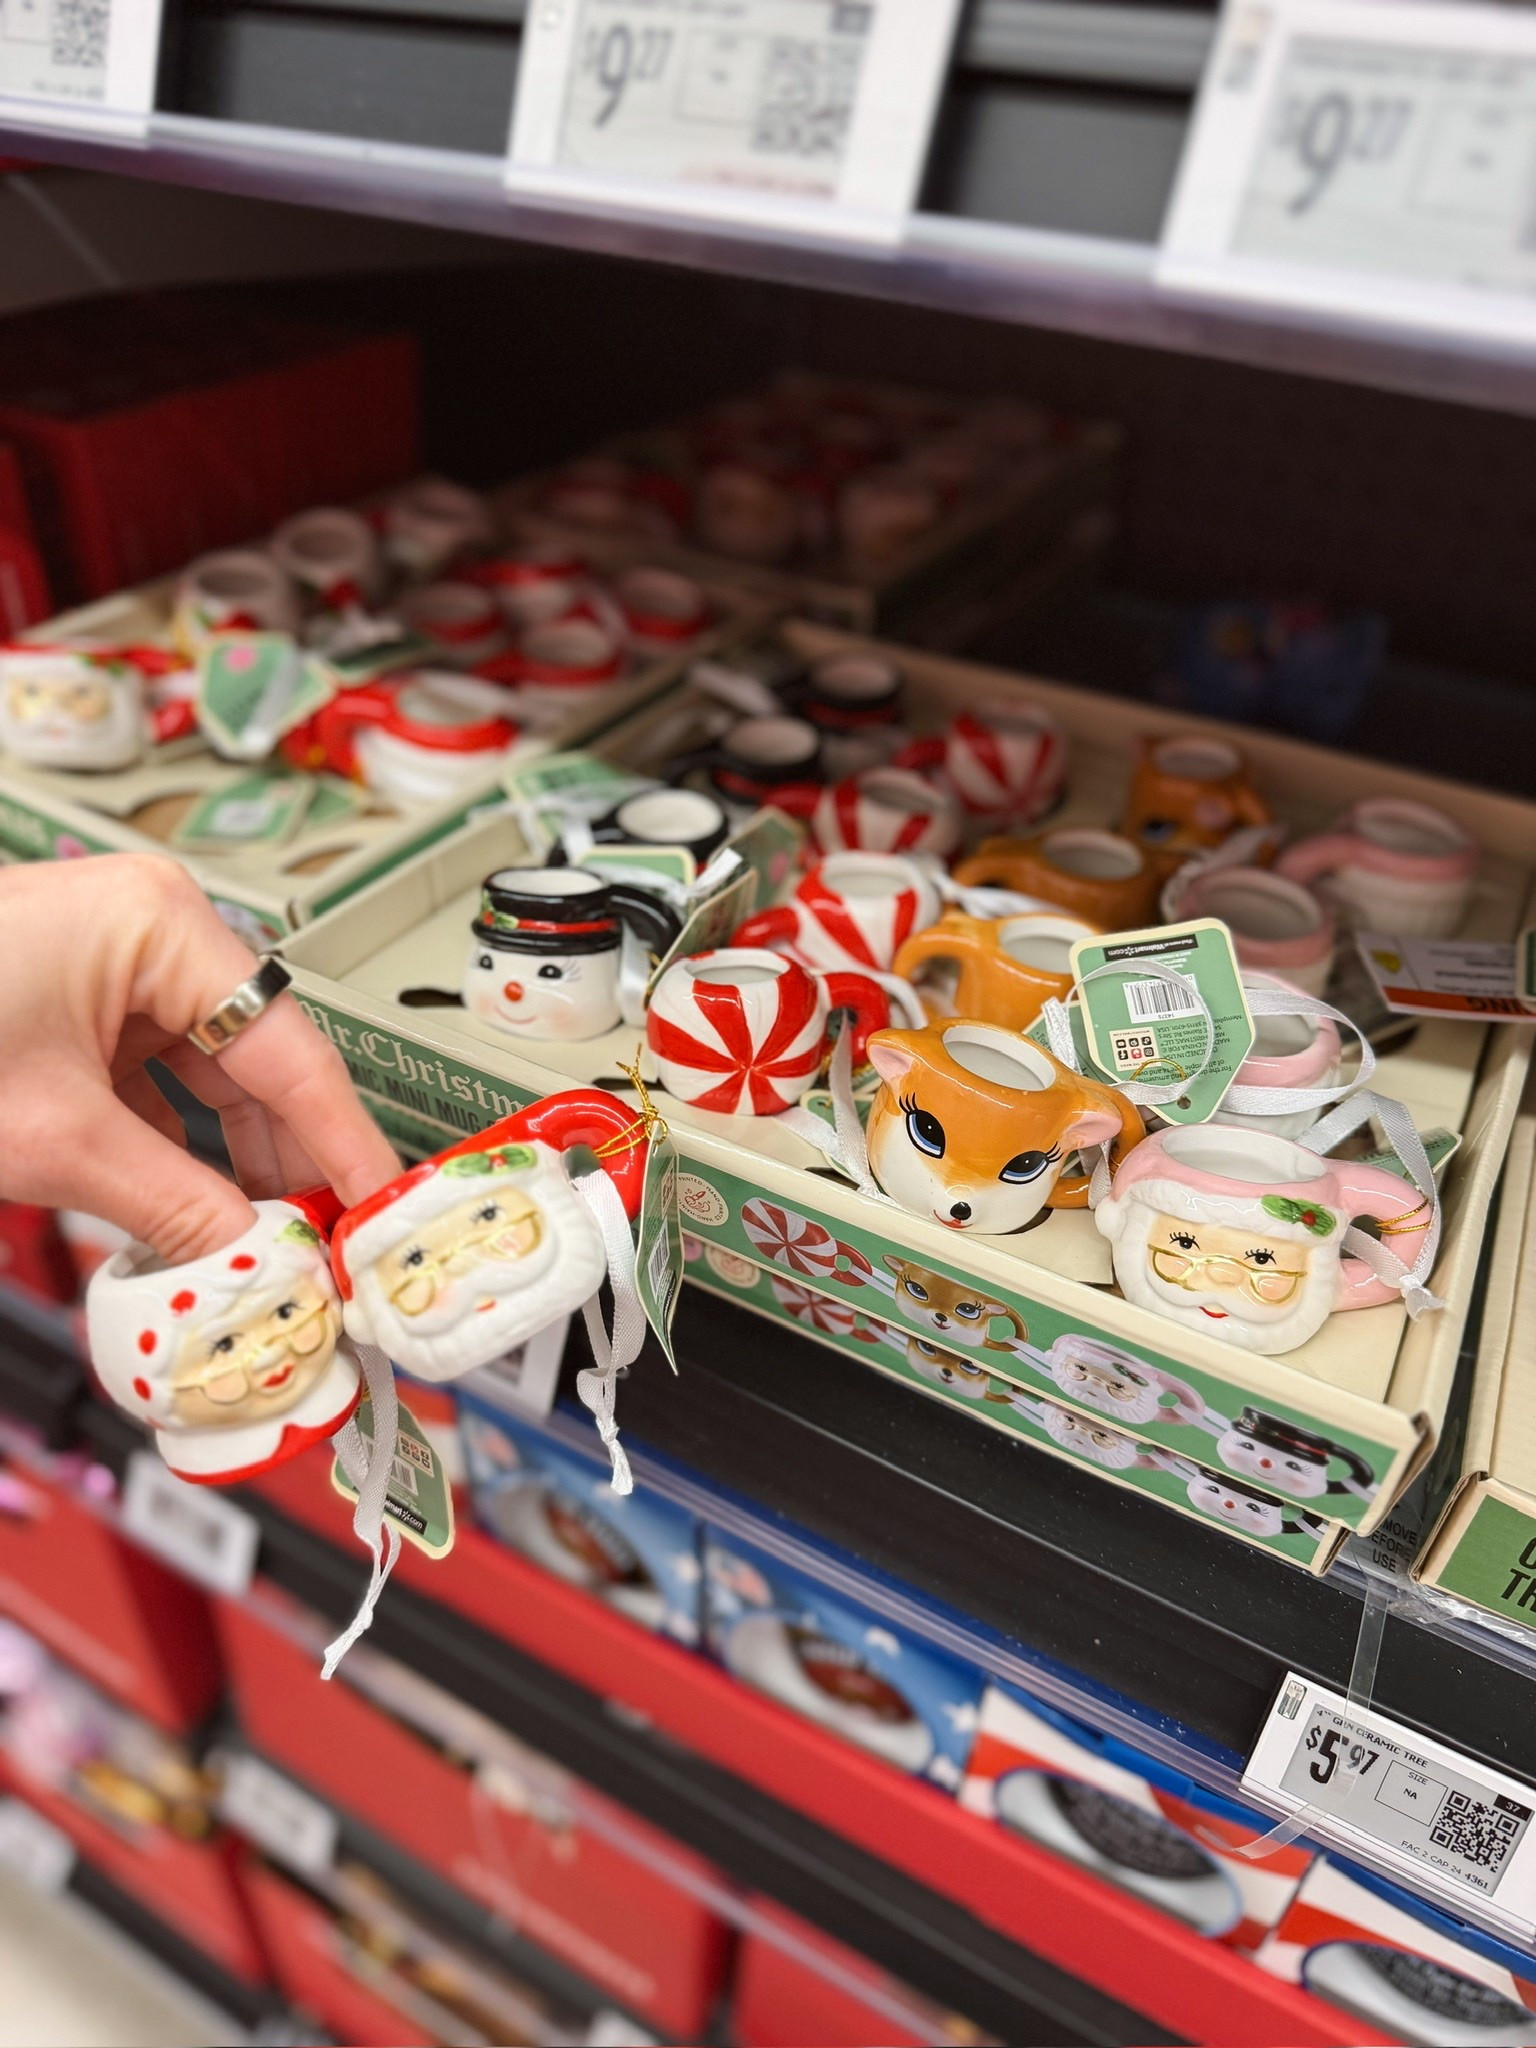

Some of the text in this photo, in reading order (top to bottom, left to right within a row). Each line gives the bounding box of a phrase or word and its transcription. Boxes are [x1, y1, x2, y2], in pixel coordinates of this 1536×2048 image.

[1157, 1012, 1175, 1020] 14375
[1182, 1029, 1202, 1037] Raines
[1180, 1042, 1202, 1050] CHINA
[1213, 1038, 1230, 1046] MAD
[384, 1078, 432, 1118] MINI
[435, 1099, 482, 1131] MUG
[1378, 1521, 1418, 1545] MOVE
[1372, 1547, 1398, 1574] USE
[1501, 1568, 1536, 1613] TR
[1332, 1716, 1355, 1732] GRN
[1355, 1727, 1401, 1756] CERAMIC
[1404, 1750, 1429, 1768] TREE
[1408, 1771, 1429, 1785] SIZE
[1403, 1787, 1418, 1800] NA
[1505, 1801, 1520, 1814] 37
[1401, 1839, 1489, 1890] FAC 2 CAP 24 4361
